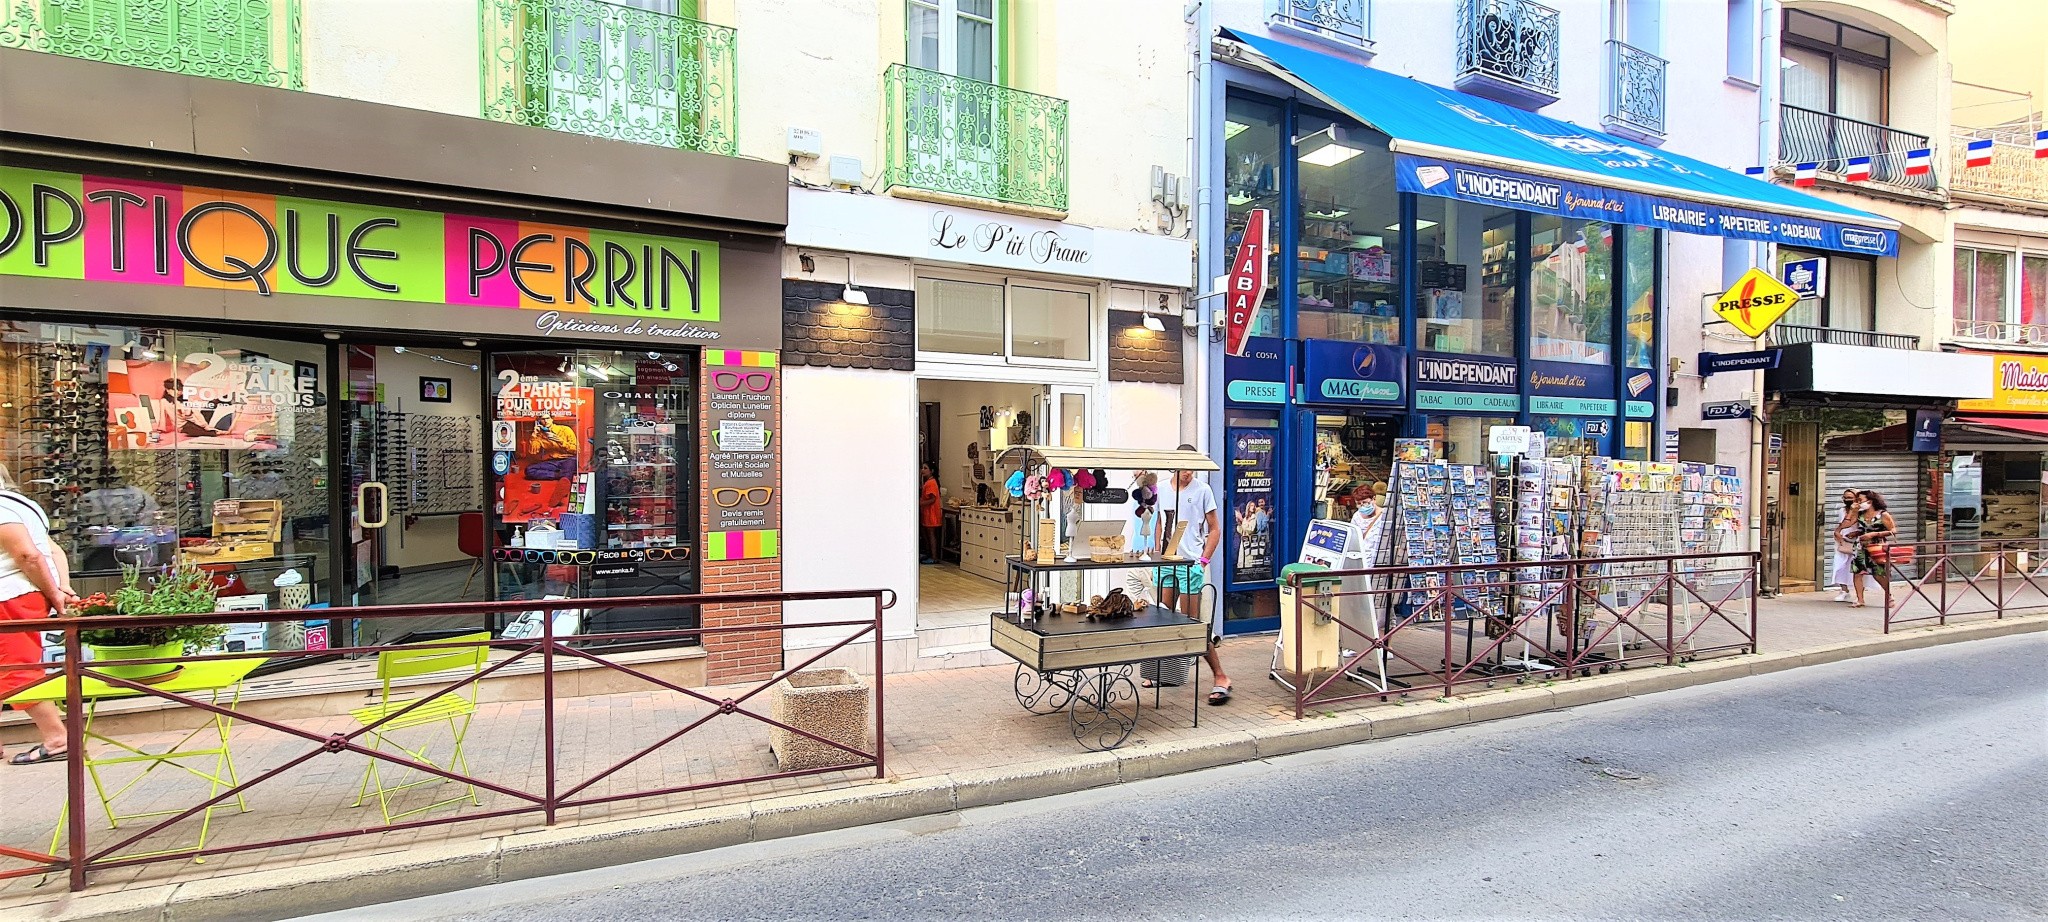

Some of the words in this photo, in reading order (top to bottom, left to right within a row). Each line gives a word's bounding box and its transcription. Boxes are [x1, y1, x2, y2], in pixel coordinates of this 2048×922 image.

[1456, 170, 1561, 208] L'INDÉPENDANT
[1564, 190, 1574, 204] le
[1570, 194, 1604, 211] journal
[1605, 200, 1624, 213] d'ici
[1652, 204, 1707, 227] LIBRAIRIE
[1780, 222, 1822, 241] CADEAUX
[930, 210, 968, 250] Le
[973, 222, 1027, 253] P'tit
[1029, 230, 1092, 265] Franc
[0, 182, 399, 297] PTIQUE
[468, 226, 700, 312] PERRIN
[1233, 244, 1257, 325] TABAC
[1718, 293, 1786, 312] PRESSE
[536, 310, 620, 336] Opticiens
[623, 319, 643, 335] de
[647, 323, 721, 340] tradition
[1255, 351, 1278, 360] COSTA
[1417, 359, 1517, 385] L'INDÉPENDANT
[229, 370, 317, 394] PAIRE
[1535, 373, 1568, 389] journal
[1569, 374, 1587, 387] d'ici
[520, 382, 574, 398] PAIRE
[1245, 386, 1277, 397] PRESSE
[1327, 382, 1360, 396] MAG
[1359, 383, 1397, 401] presse
[183, 386, 248, 404] POUR
[257, 391, 315, 407] TOUS
[711, 392, 740, 400] Laurent
[741, 393, 771, 401] Fruchon
[1420, 395, 1443, 405] TABAC
[1454, 396, 1473, 406] LOTO
[1483, 397, 1516, 407] CADEAUX
[497, 399, 532, 411] POUR
[536, 399, 572, 411] TOUS
[710, 401, 741, 410] Opticien
[742, 402, 772, 410] Lunetier
[1536, 401, 1564, 410] LIBRAIRIE
[1579, 402, 1608, 412] PAPETERIE
[1627, 404, 1644, 413] TABAC
[1709, 406, 1728, 415] FDJ
[1586, 423, 1599, 432] FDJ
[709, 451, 731, 461] Agréé
[732, 452, 749, 460] Tiers
[750, 452, 774, 461] payant
[714, 461, 743, 469] Sécurité
[744, 461, 770, 469] Sociale
[721, 470, 729, 478] et
[730, 470, 763, 478] Mutuelles
[1251, 478, 1272, 487] TICKETS
[722, 510, 742, 518] Devis
[743, 509, 763, 517] remis
[720, 518, 765, 528] gratuitement
[598, 550, 620, 559] Face
[628, 549, 644, 558] Cie
[308, 635, 325, 645] LLA
